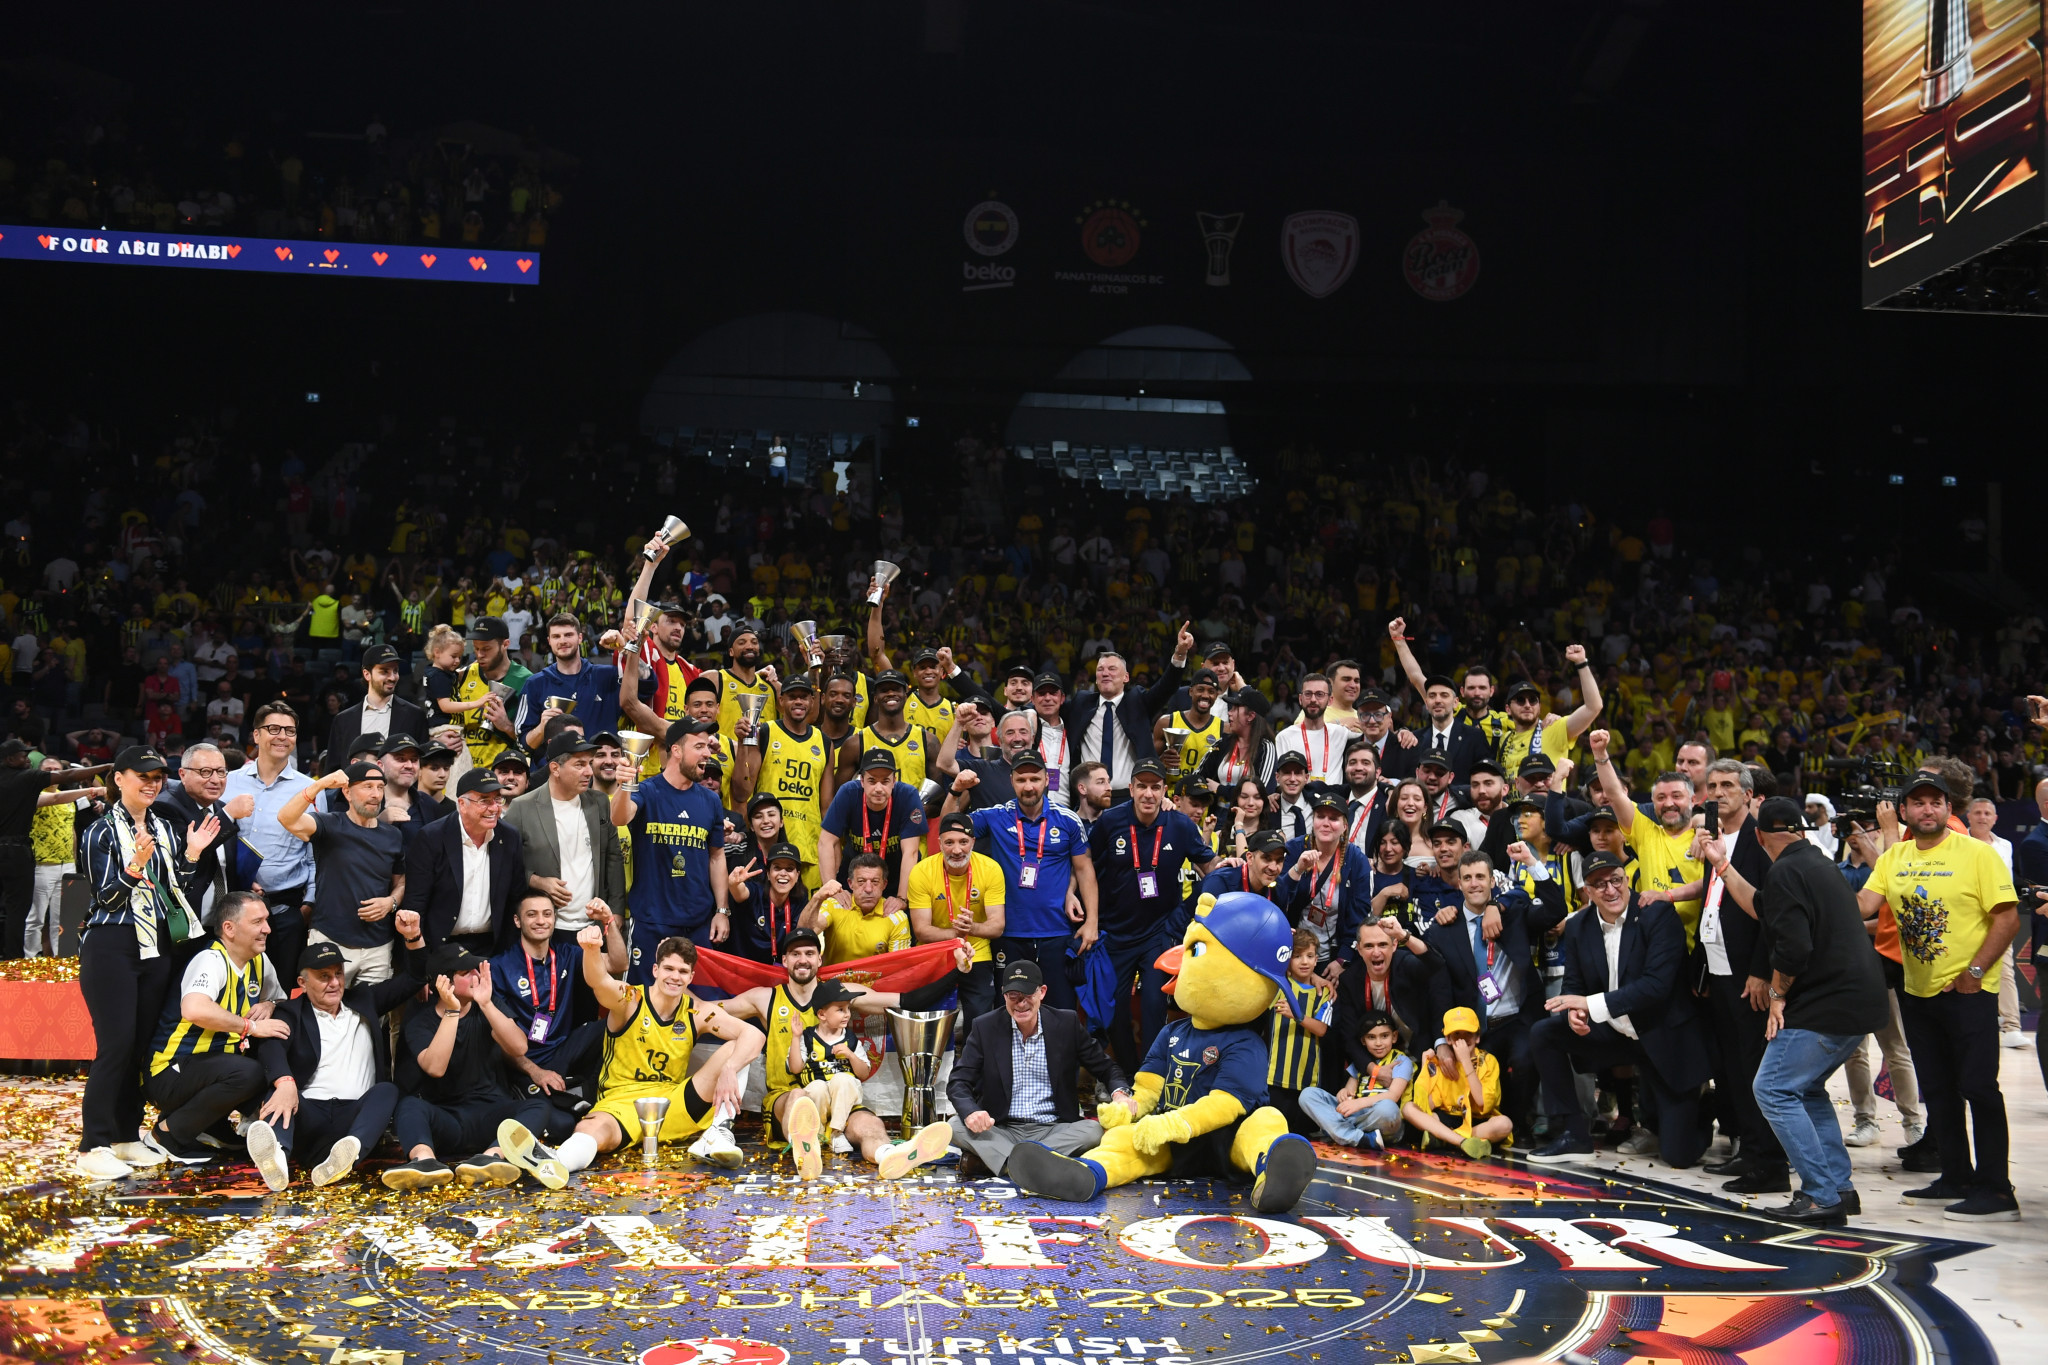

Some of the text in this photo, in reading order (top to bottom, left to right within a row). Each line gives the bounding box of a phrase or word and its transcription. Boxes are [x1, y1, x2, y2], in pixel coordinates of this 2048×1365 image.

[49, 236, 228, 260] FOUR ABU DHABI
[963, 261, 1016, 281] beko
[1054, 271, 1164, 285] PANATHINAIKOS BC
[1090, 284, 1129, 294] AKTOR
[664, 705, 686, 718] eko
[463, 726, 492, 742] eko
[1186, 748, 1199, 766] 0
[785, 758, 811, 781] 50
[778, 778, 813, 797] beko
[783, 809, 807, 821] PASHA
[652, 834, 706, 850] BASKETBALL
[645, 1049, 670, 1072] 13
[958, 1214, 1789, 1272] FOUR
[434, 1287, 1367, 1311] ABU DHABI 2025
[828, 1336, 1186, 1356] TURKISH
